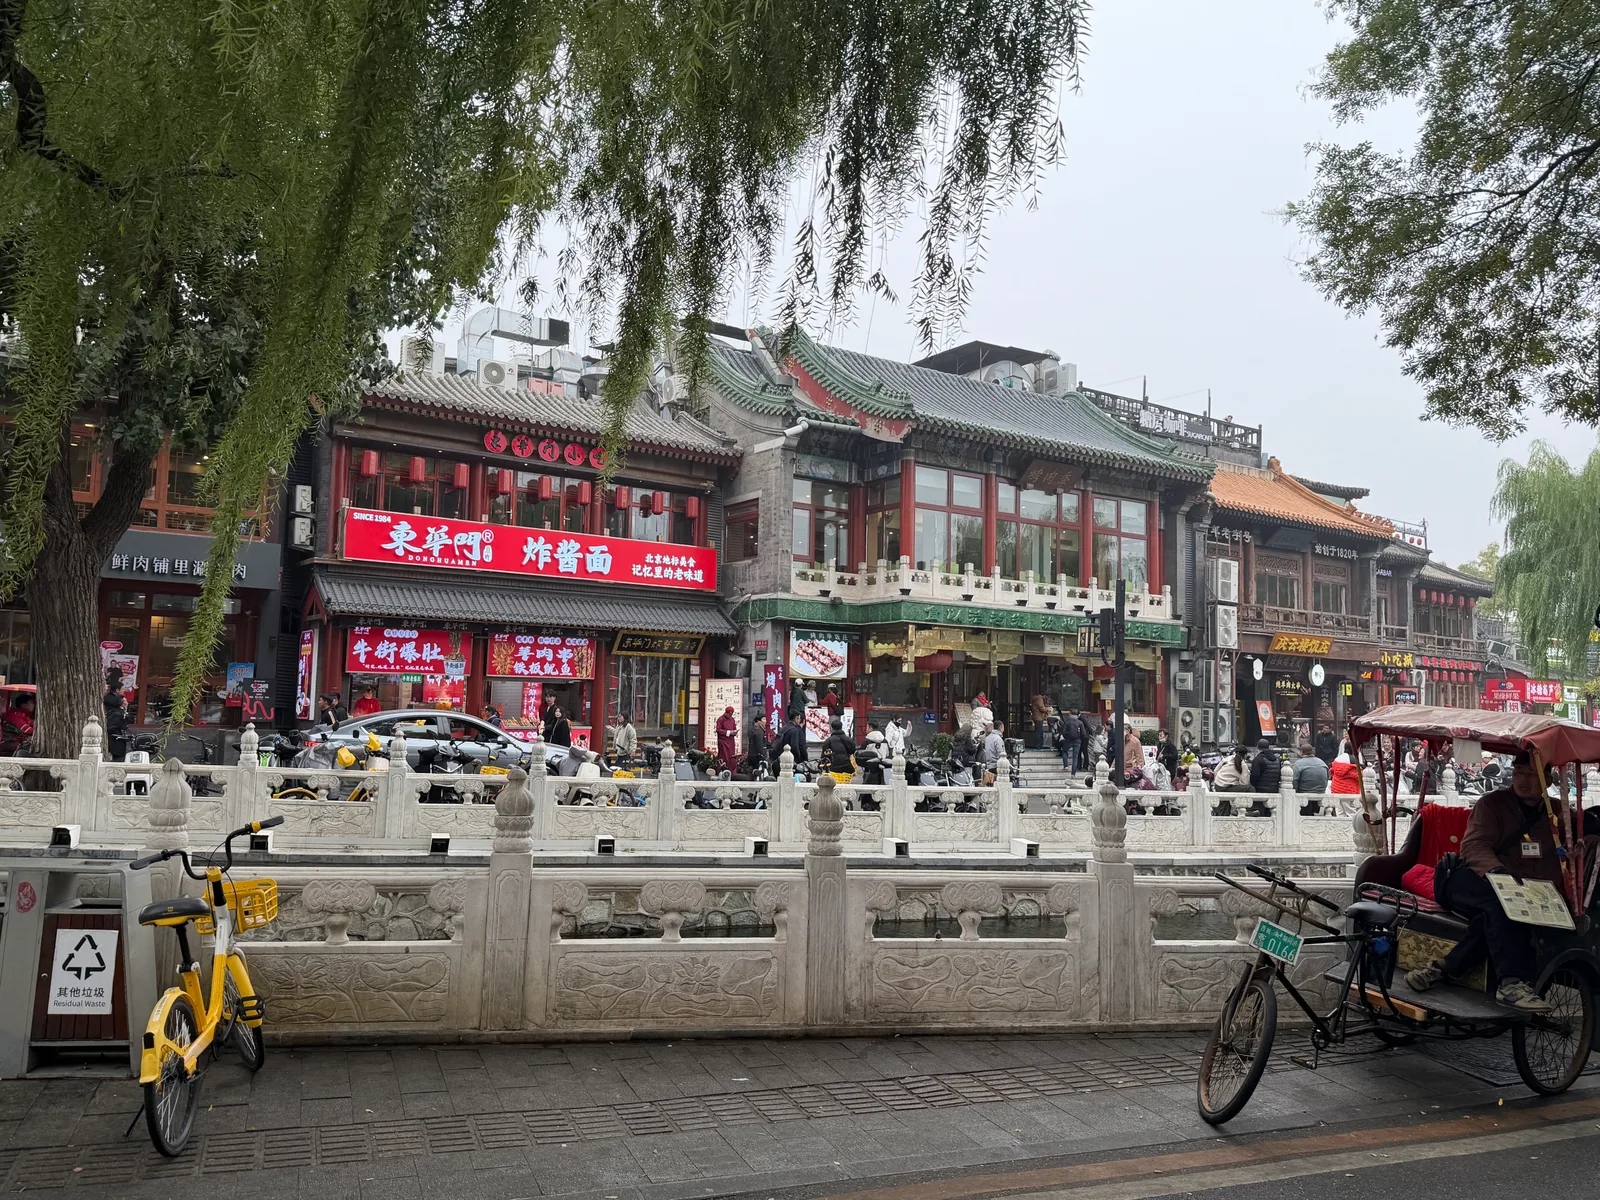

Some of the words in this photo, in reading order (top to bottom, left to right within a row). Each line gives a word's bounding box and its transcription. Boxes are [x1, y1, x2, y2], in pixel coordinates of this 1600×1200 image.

[353, 512, 374, 521] SINCE
[374, 514, 391, 523] 1984
[408, 554, 477, 566] DONGHUAMEN
[522, 536, 612, 575] 炸酱面
[1315, 543, 1359, 560] 始创于1820年
[111, 553, 247, 579] 鲜肉铺里涮肉
[645, 553, 696, 568] 北京地标美食
[632, 564, 704, 583] 记忆里的老味道
[353, 638, 445, 664] 牛街爆肚
[514, 646, 573, 663] 羊肉串
[513, 661, 572, 676] 铁板鱿鱼
[1531, 683, 1554, 696] 冰糖葫芦
[1267, 938, 1296, 962] 0166
[56, 987, 104, 998] 其他垃圾
